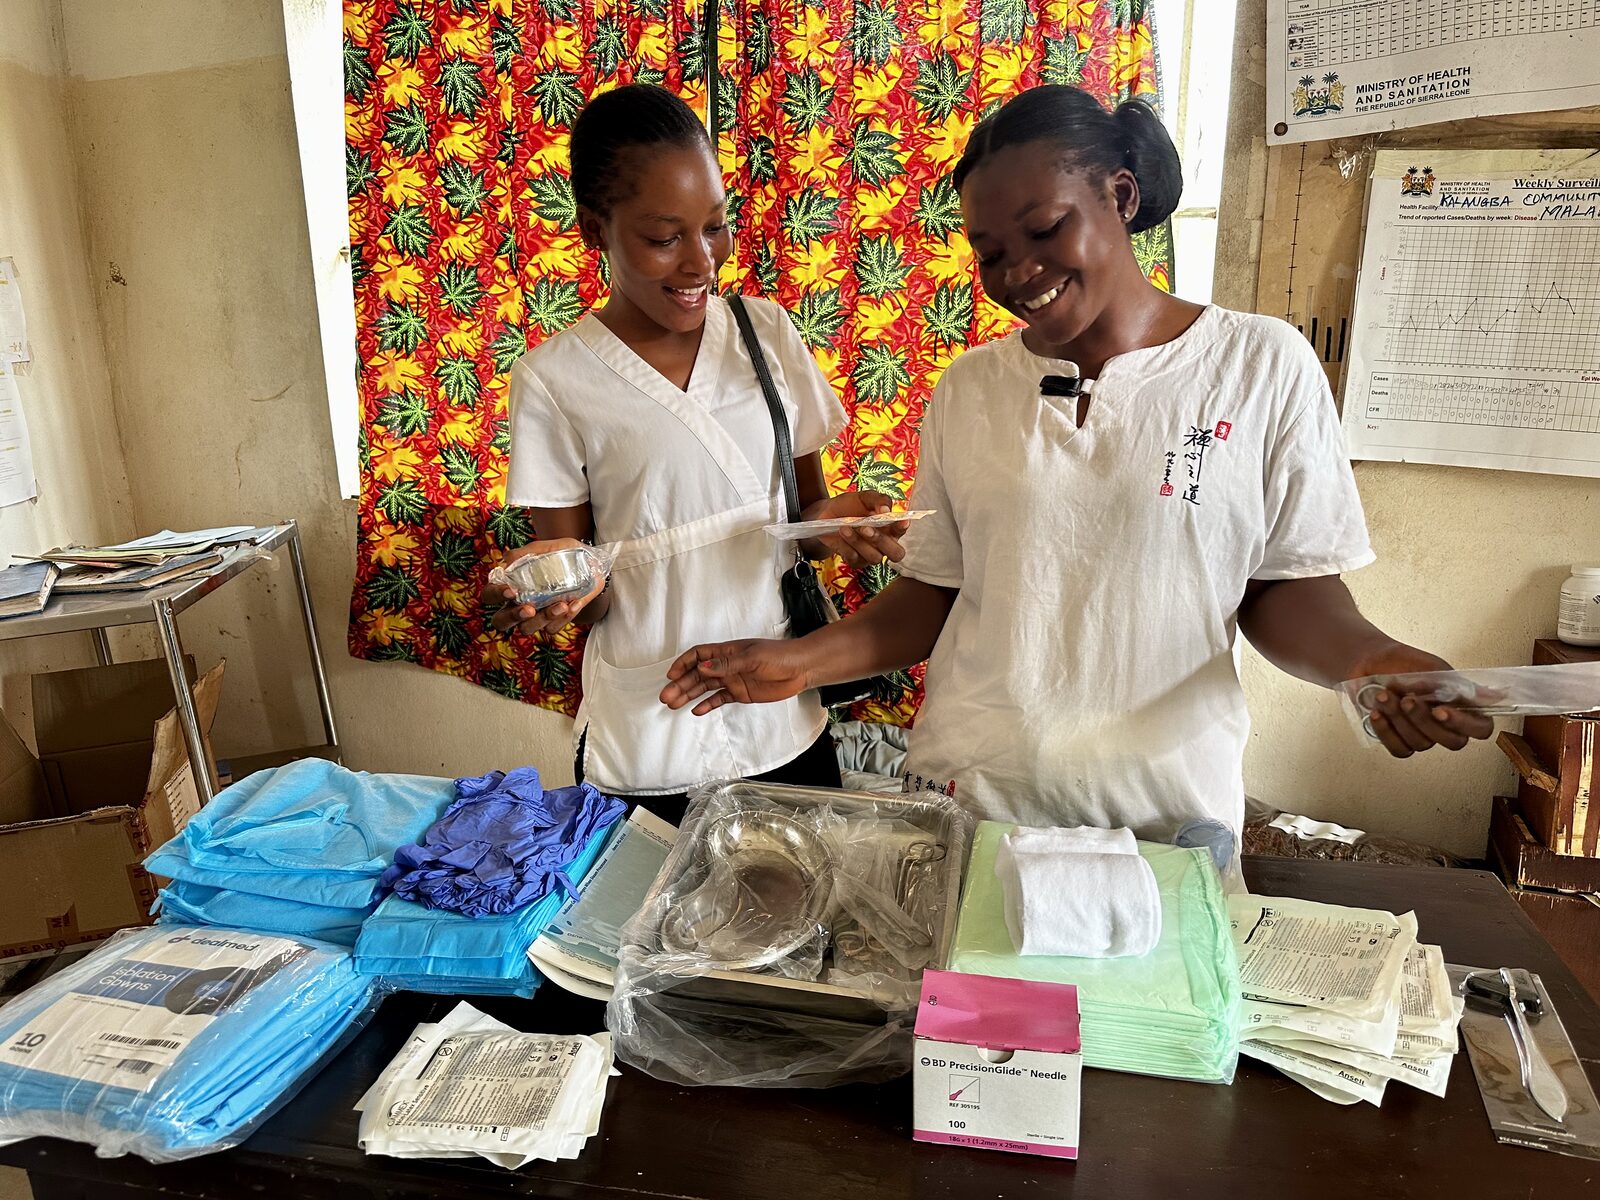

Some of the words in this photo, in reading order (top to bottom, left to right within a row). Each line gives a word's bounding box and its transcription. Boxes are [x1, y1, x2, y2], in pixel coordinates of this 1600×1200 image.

[1356, 78, 1406, 94] MINISTRY
[1409, 74, 1423, 85] OF
[1427, 67, 1471, 81] HEALTH
[1356, 94, 1382, 105] AND
[1389, 78, 1470, 100] SANITATION
[1370, 100, 1404, 110] REPUBLIC
[1418, 93, 1443, 102] SIERRA
[1446, 89, 1470, 97] LEONE
[1514, 179, 1554, 190] Weekly
[1539, 204, 1600, 220] MALA
[191, 938, 260, 951] dealmed
[112, 967, 176, 982] Isolation
[100, 975, 151, 990] Gowns
[15, 1032, 46, 1047] 10
[413, 1036, 427, 1044] 7
[932, 1059, 946, 1068] BD
[1030, 1070, 1067, 1080] Needle
[1402, 1062, 1429, 1075] Ansell
[1338, 1070, 1366, 1086] Ansell
[972, 1138, 997, 1146] (1.2mm
[1004, 1142, 1028, 1150] 25mm)
